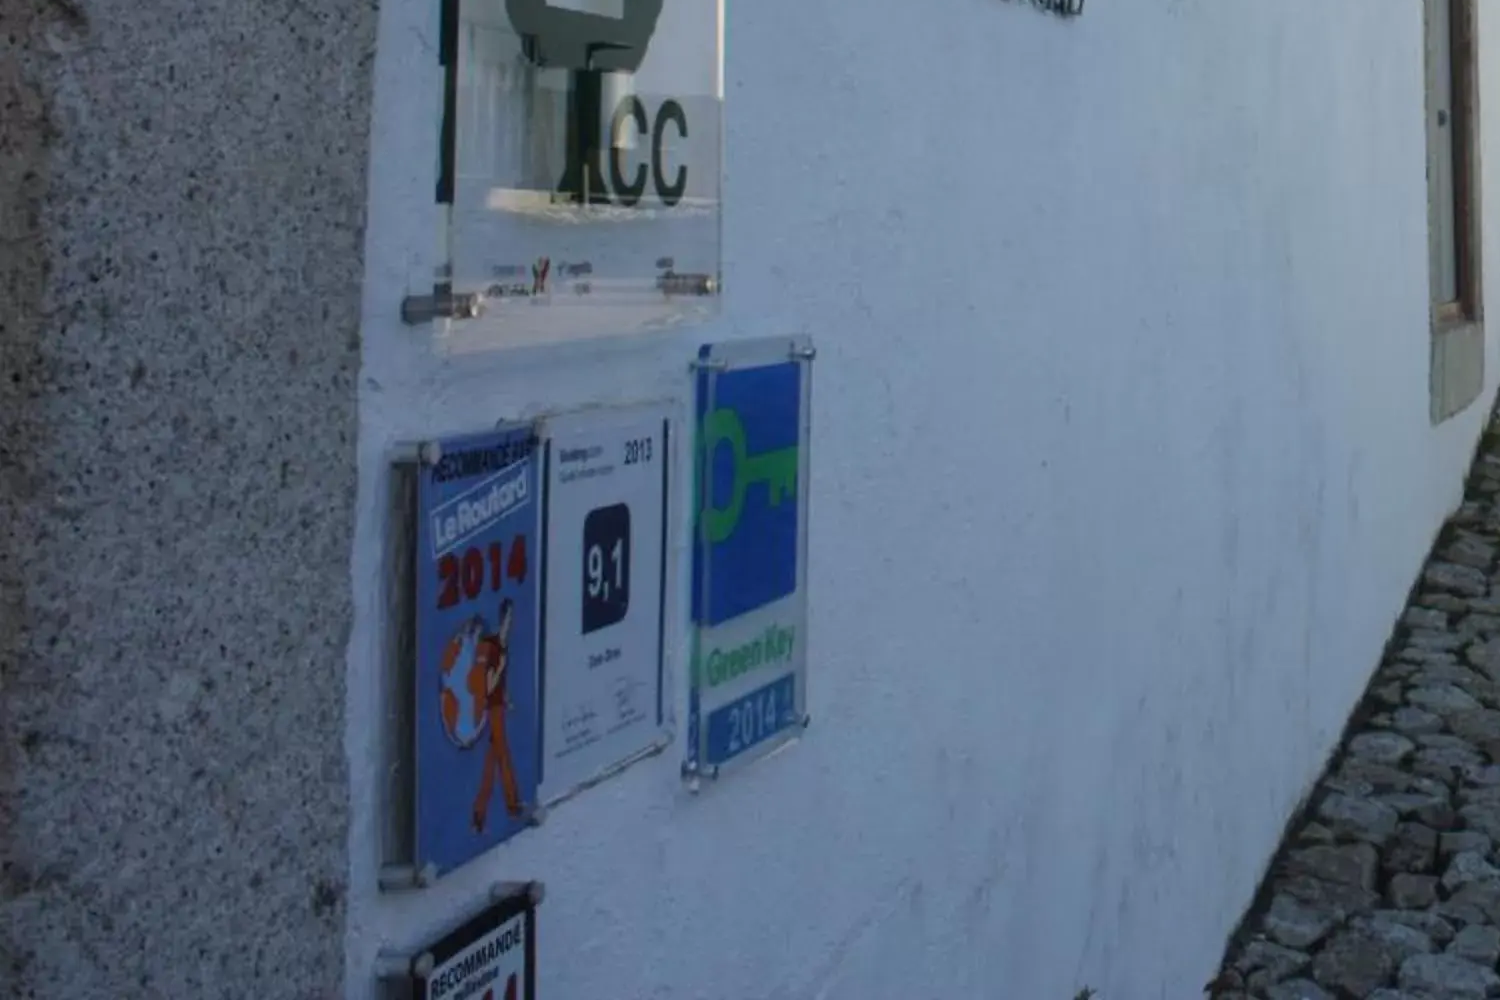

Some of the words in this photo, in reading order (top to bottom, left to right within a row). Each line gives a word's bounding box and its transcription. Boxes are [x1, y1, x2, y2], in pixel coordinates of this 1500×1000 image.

[624, 436, 653, 465] 2013
[436, 534, 528, 610] 2014
[588, 538, 623, 601] 9,1
[726, 688, 777, 752] 2014
